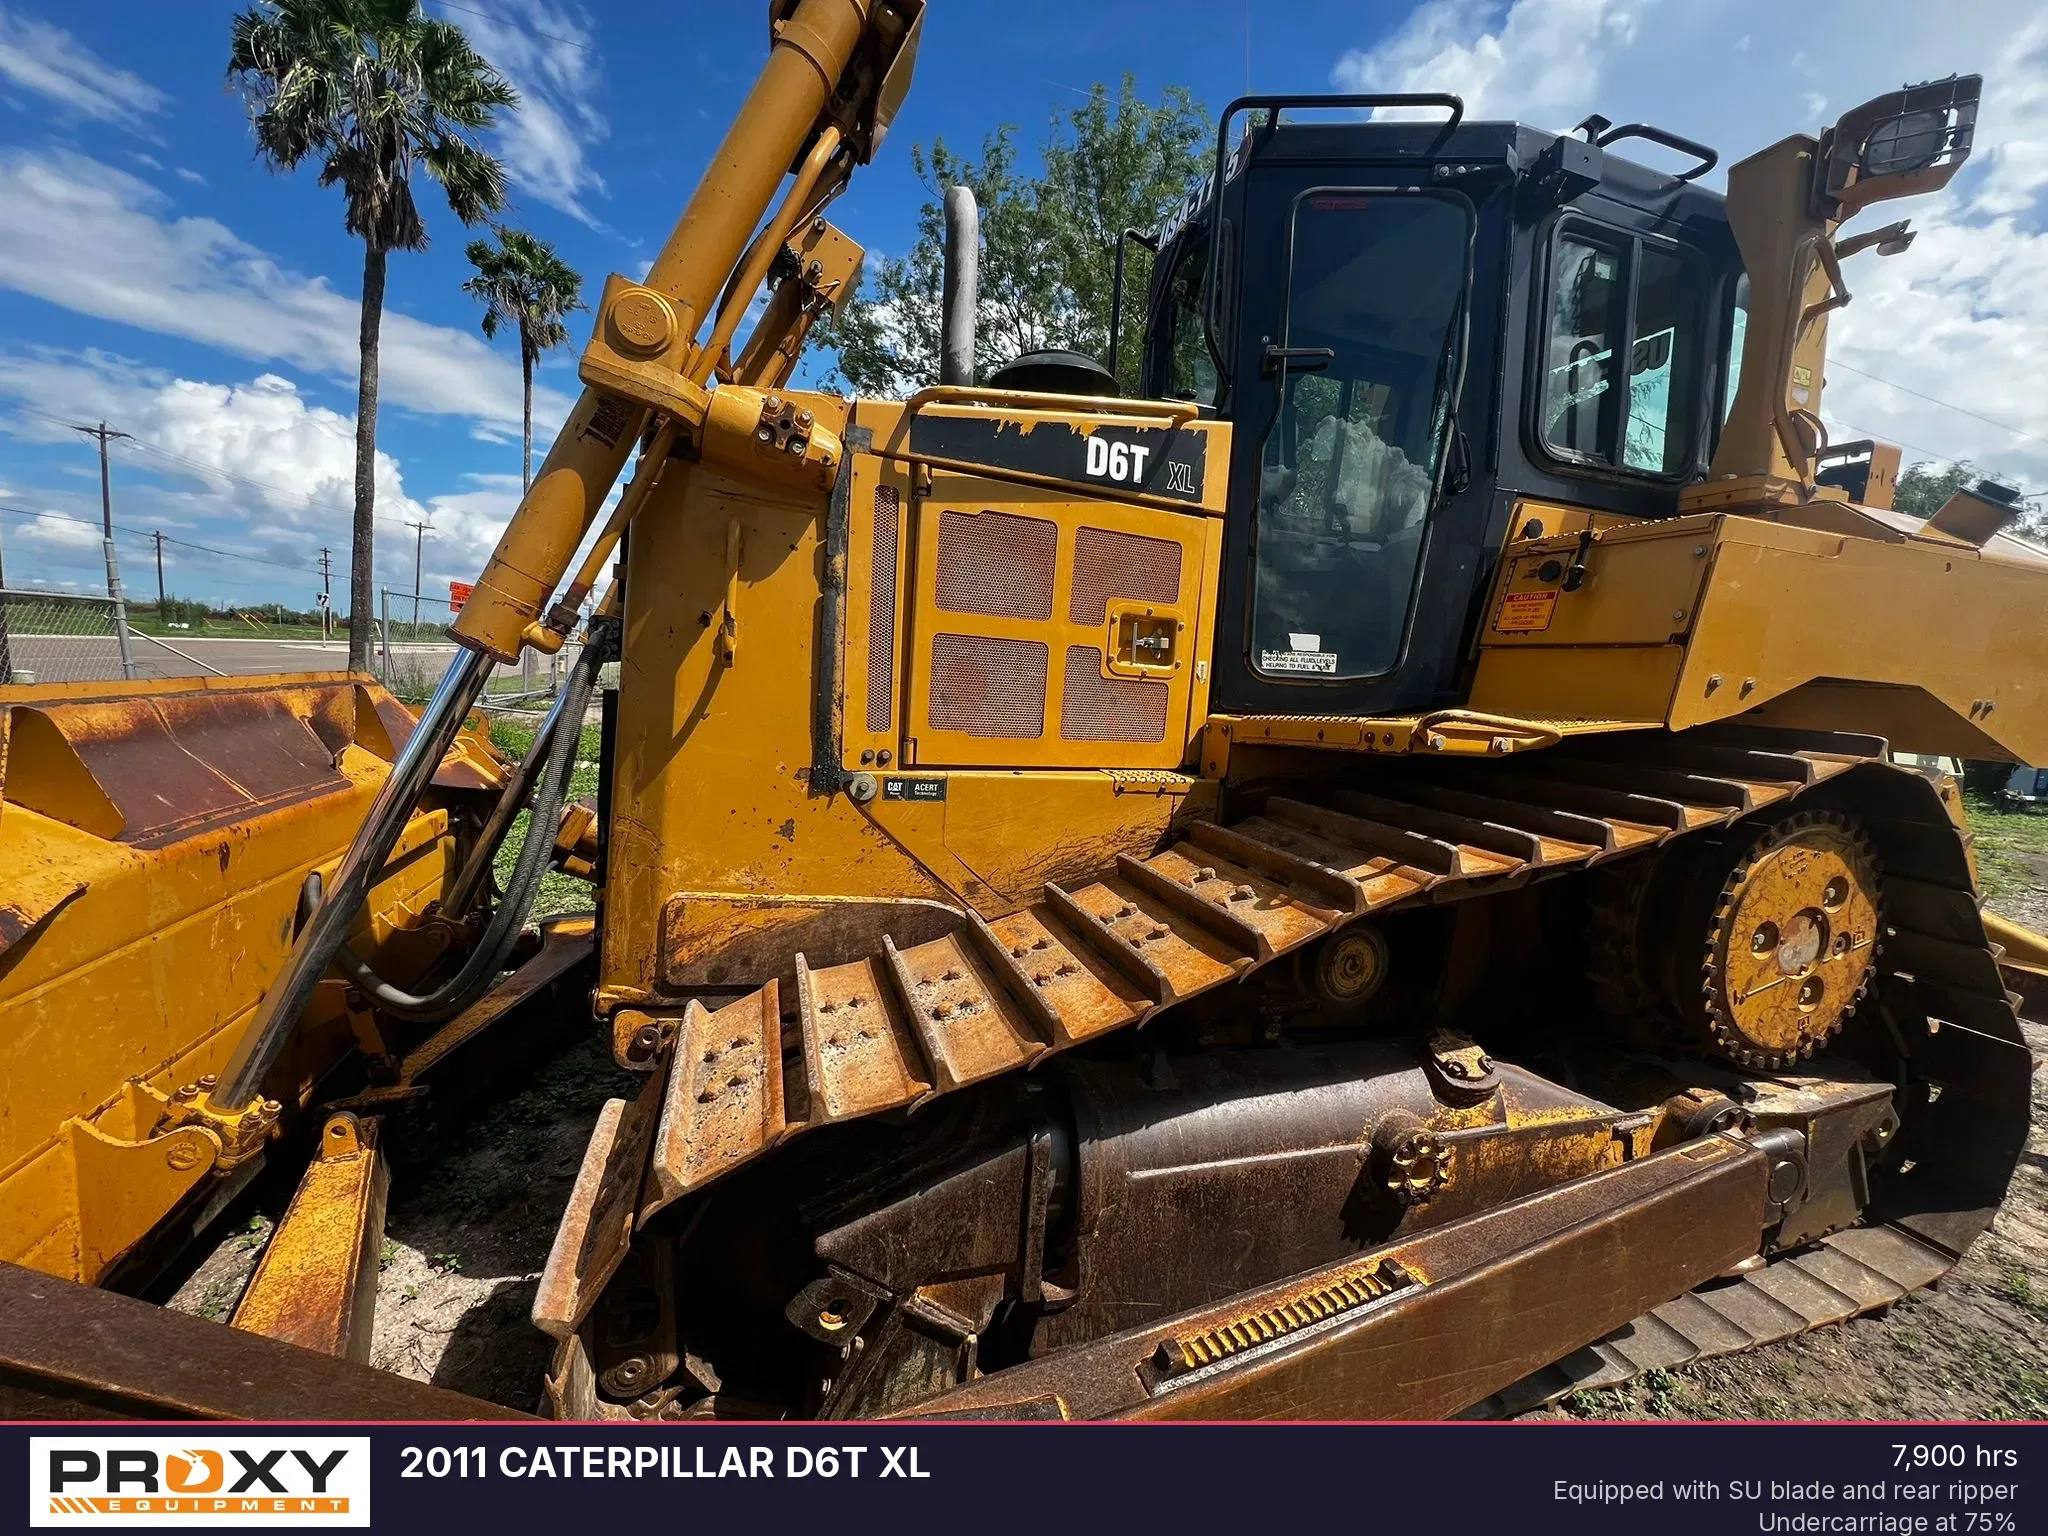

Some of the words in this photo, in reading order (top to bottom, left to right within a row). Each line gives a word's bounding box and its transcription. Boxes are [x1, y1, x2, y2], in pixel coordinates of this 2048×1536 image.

[1086, 436, 1150, 484] D6T
[1167, 461, 1195, 494] XL
[1513, 593, 1548, 601] CAUTION
[887, 782, 903, 792] CAT
[914, 783, 939, 792] ACERT
